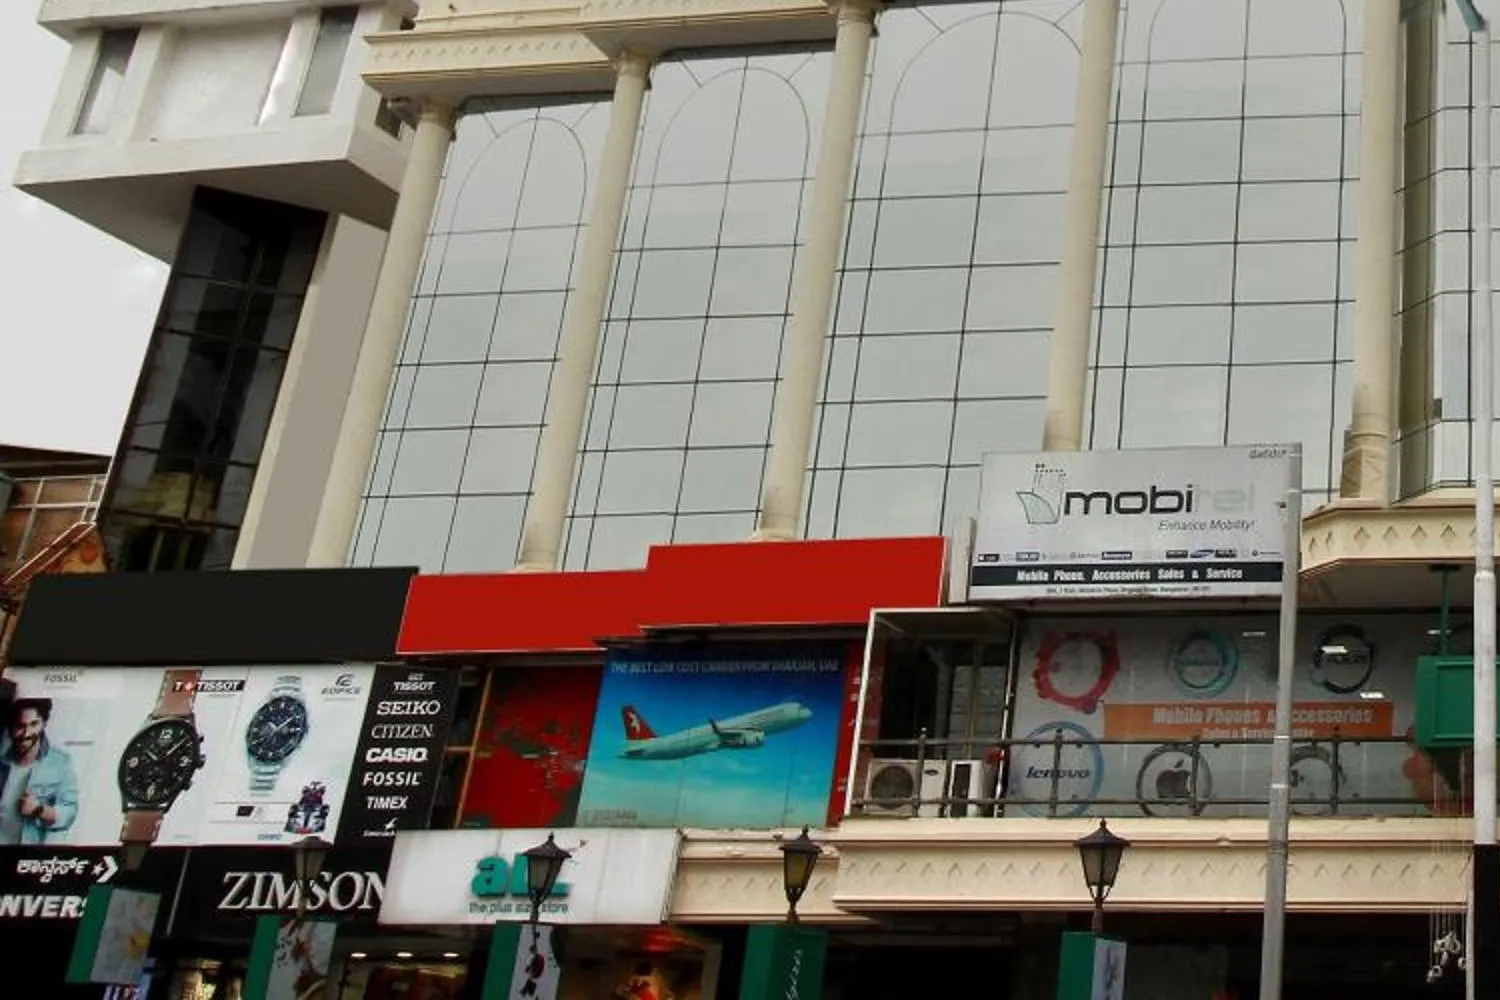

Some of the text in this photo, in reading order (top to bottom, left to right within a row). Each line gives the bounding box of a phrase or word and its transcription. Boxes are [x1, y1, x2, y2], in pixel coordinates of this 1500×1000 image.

[1016, 569, 1049, 582] Mobile
[1092, 569, 1151, 581] Accessories
[1157, 567, 1185, 580] Sales
[1206, 567, 1243, 579] Service
[197, 681, 240, 691] TISSOT
[394, 681, 437, 692] TISSOT
[376, 700, 441, 716] SEIKO
[1152, 707, 1201, 724] Mobile
[1290, 708, 1372, 723] ccessories
[371, 723, 435, 739] CITIZEN
[365, 747, 429, 763] CASIO
[362, 771, 422, 786] FOSSIL
[1026, 766, 1091, 779] lenovo
[366, 795, 409, 809] TIMEX
[218, 871, 385, 911] ZIMSON
